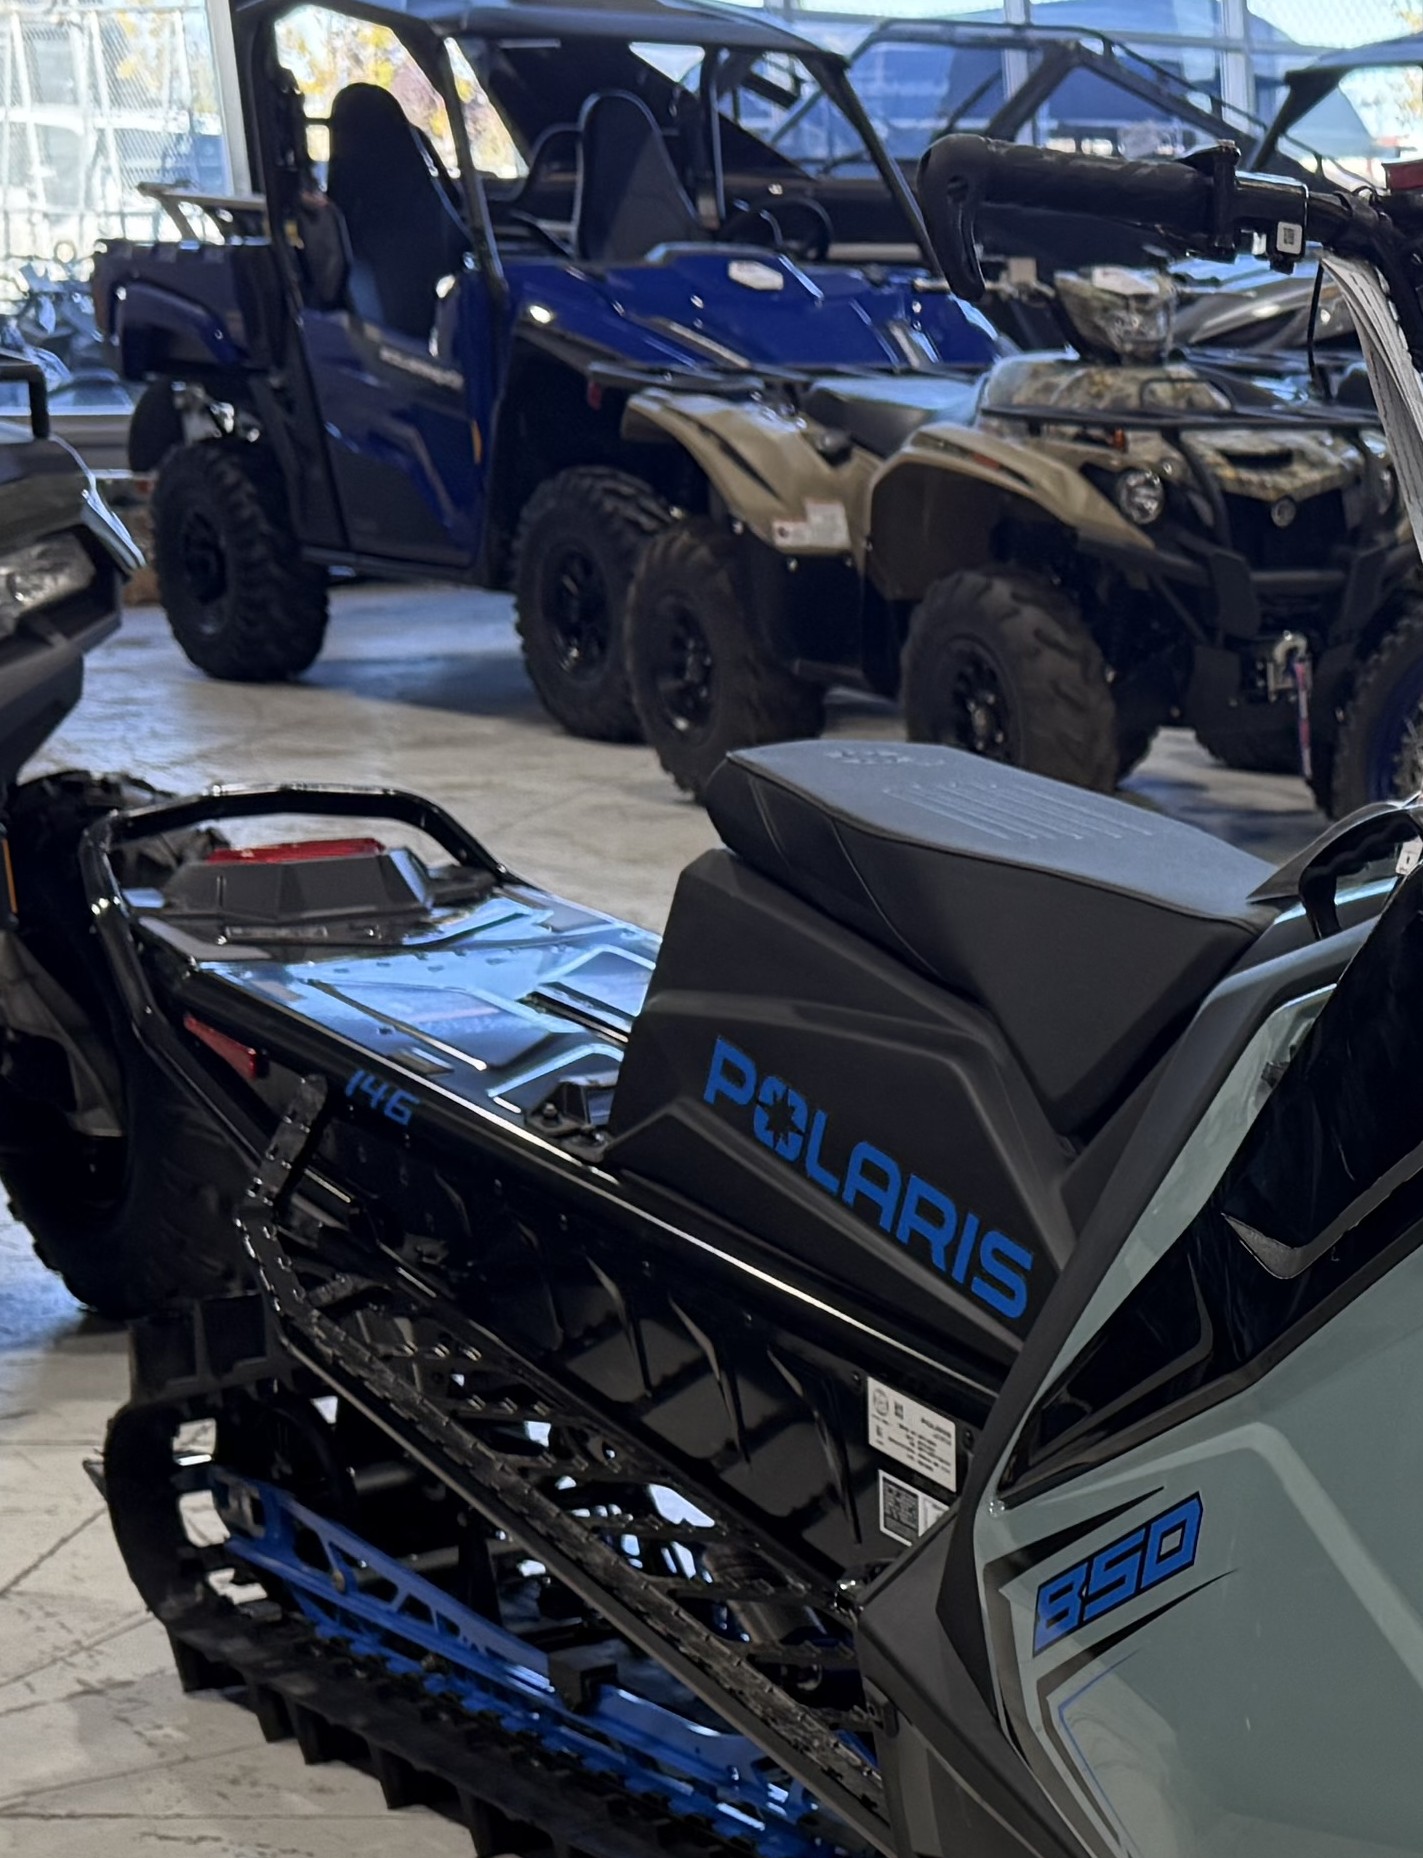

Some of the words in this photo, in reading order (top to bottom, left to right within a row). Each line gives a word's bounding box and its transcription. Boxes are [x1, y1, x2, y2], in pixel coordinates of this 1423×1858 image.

[345, 1068, 420, 1126] 146
[703, 1034, 1034, 1319] POLARIS
[1034, 1495, 1202, 1656] 850
